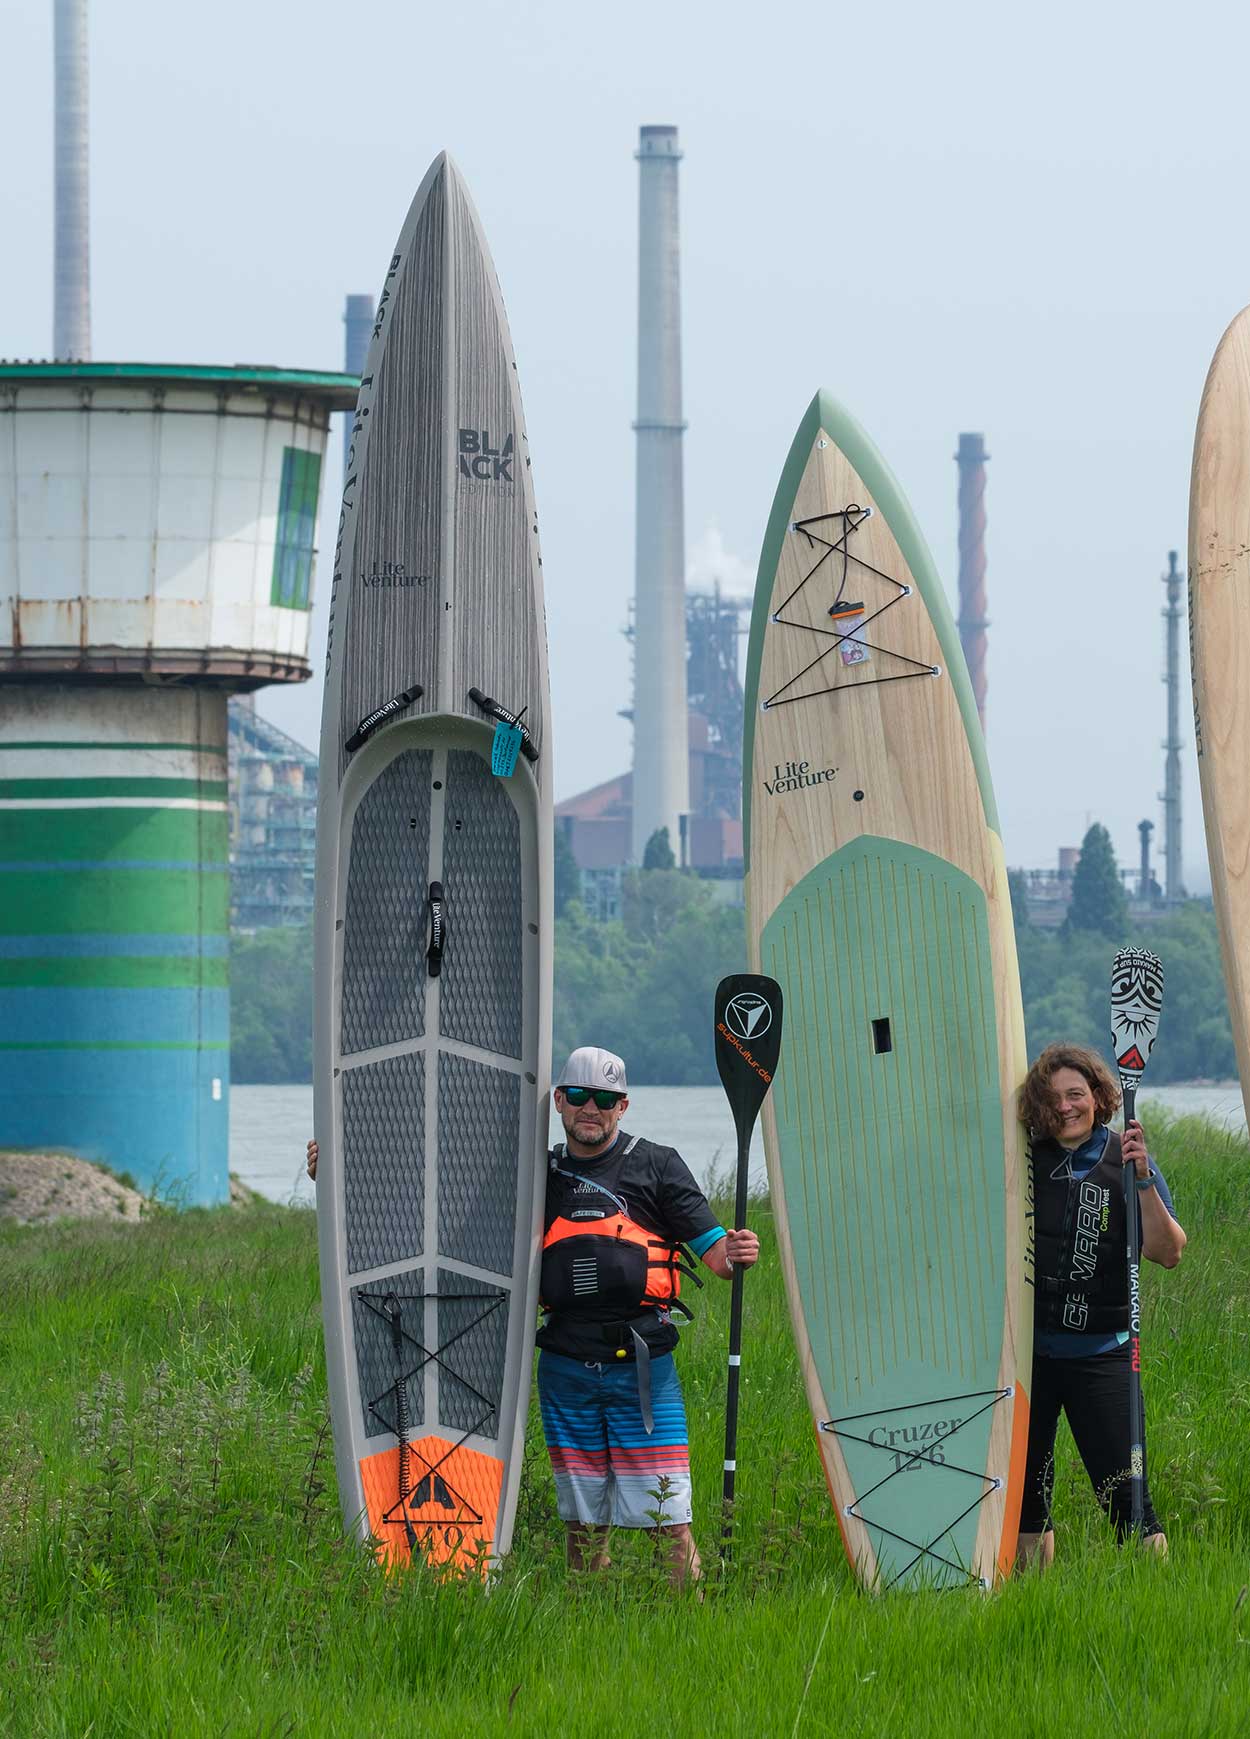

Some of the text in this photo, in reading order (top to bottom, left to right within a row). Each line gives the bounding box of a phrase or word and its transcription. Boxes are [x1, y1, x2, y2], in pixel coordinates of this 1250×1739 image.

[360, 573, 428, 588] Venture
[372, 561, 405, 575] Lite
[763, 768, 837, 796] Venture
[774, 761, 810, 781] Lite
[716, 1022, 773, 1084] supkultur.de
[1100, 1188, 1110, 1232] CompVest
[867, 1417, 963, 1449] Cruzer
